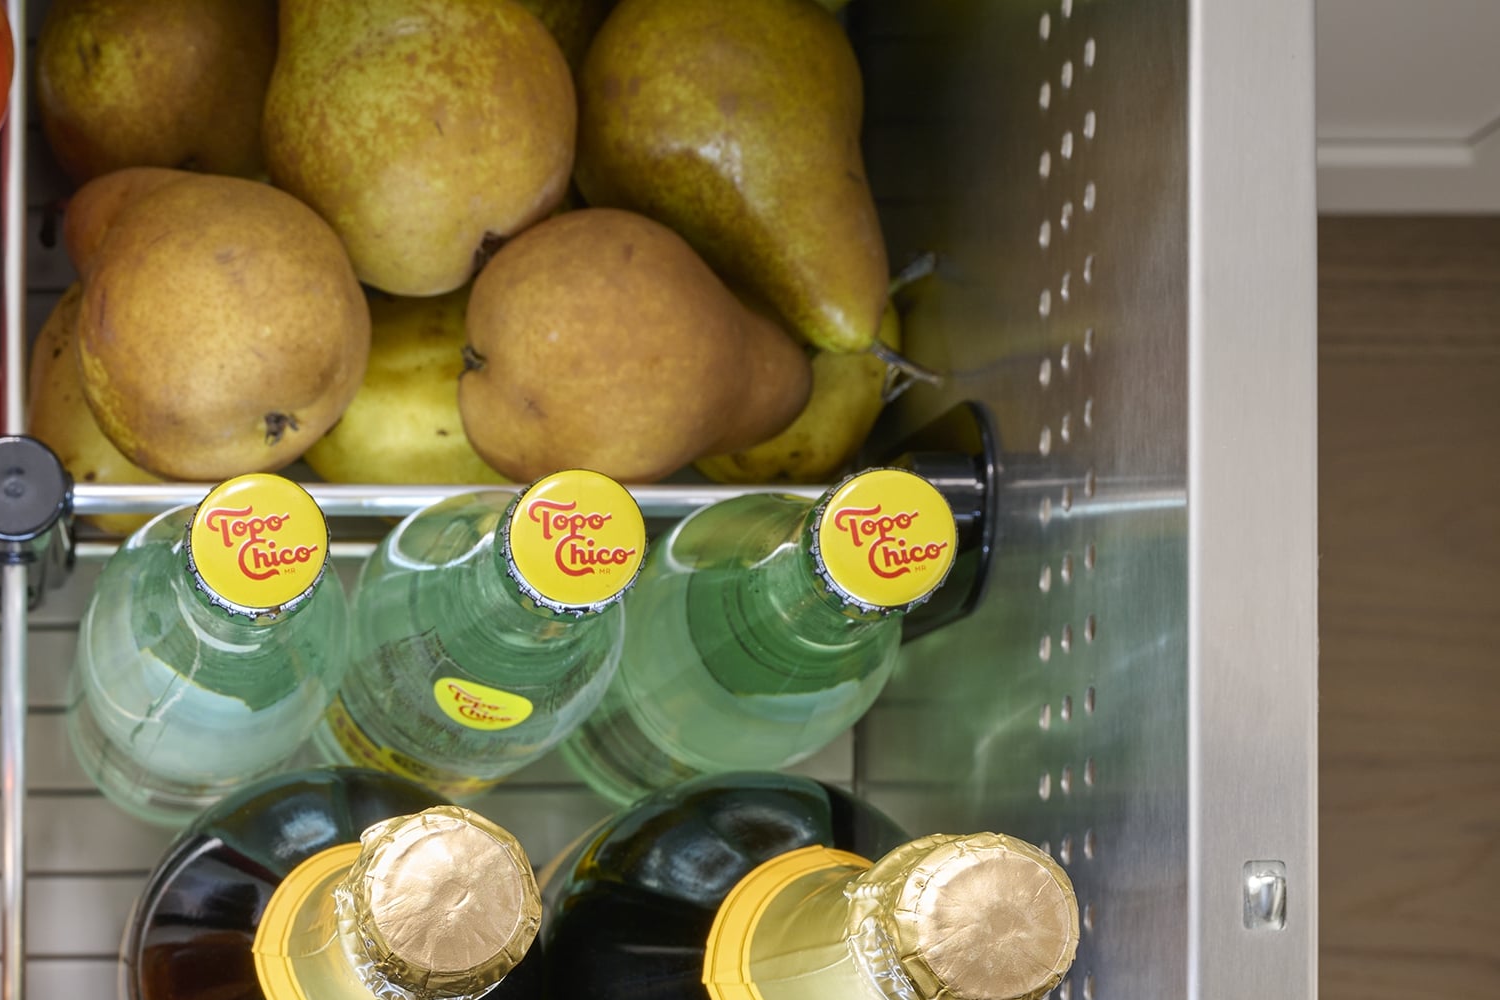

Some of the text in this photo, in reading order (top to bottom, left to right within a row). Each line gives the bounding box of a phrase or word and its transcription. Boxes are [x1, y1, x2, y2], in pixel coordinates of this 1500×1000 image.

[205, 505, 290, 547] Topo
[528, 499, 612, 540] Topo
[834, 504, 919, 547] Topo
[238, 539, 318, 580] Chico
[555, 533, 636, 577] Chico
[868, 537, 948, 579] Chico
